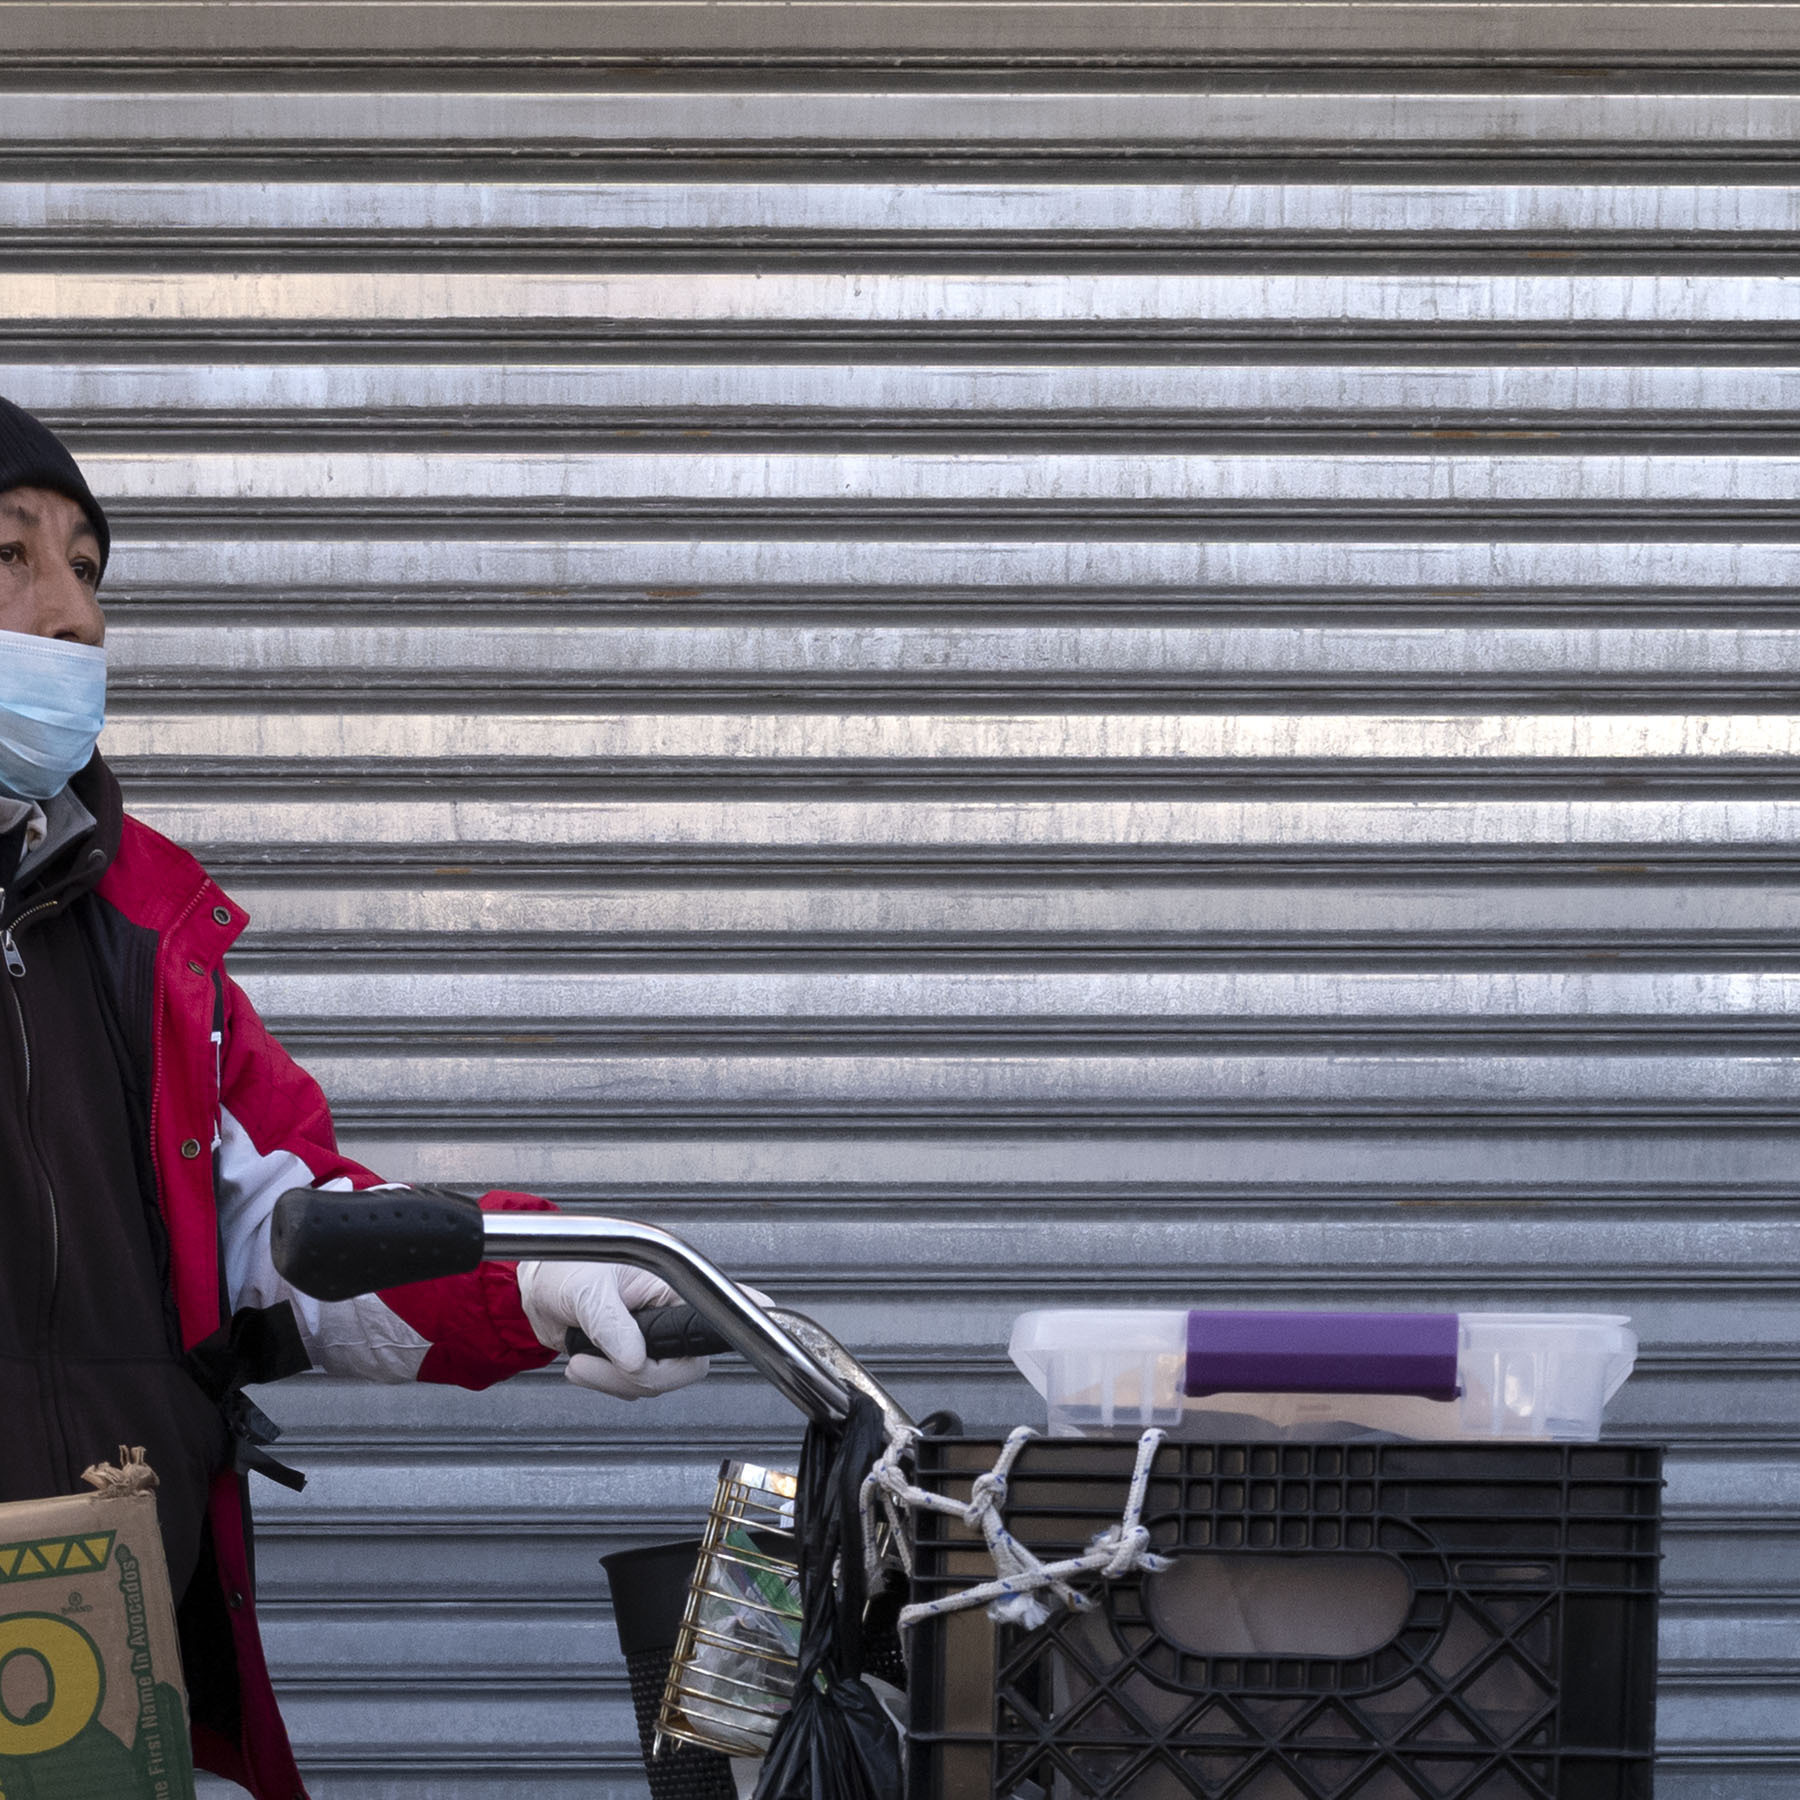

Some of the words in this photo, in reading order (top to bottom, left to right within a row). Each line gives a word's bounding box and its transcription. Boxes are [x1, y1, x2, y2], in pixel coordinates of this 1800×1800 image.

[123, 1559, 147, 1646] Avocados
[134, 1653, 149, 1671] In
[141, 1674, 158, 1728] Name
[149, 1733, 165, 1776] First
